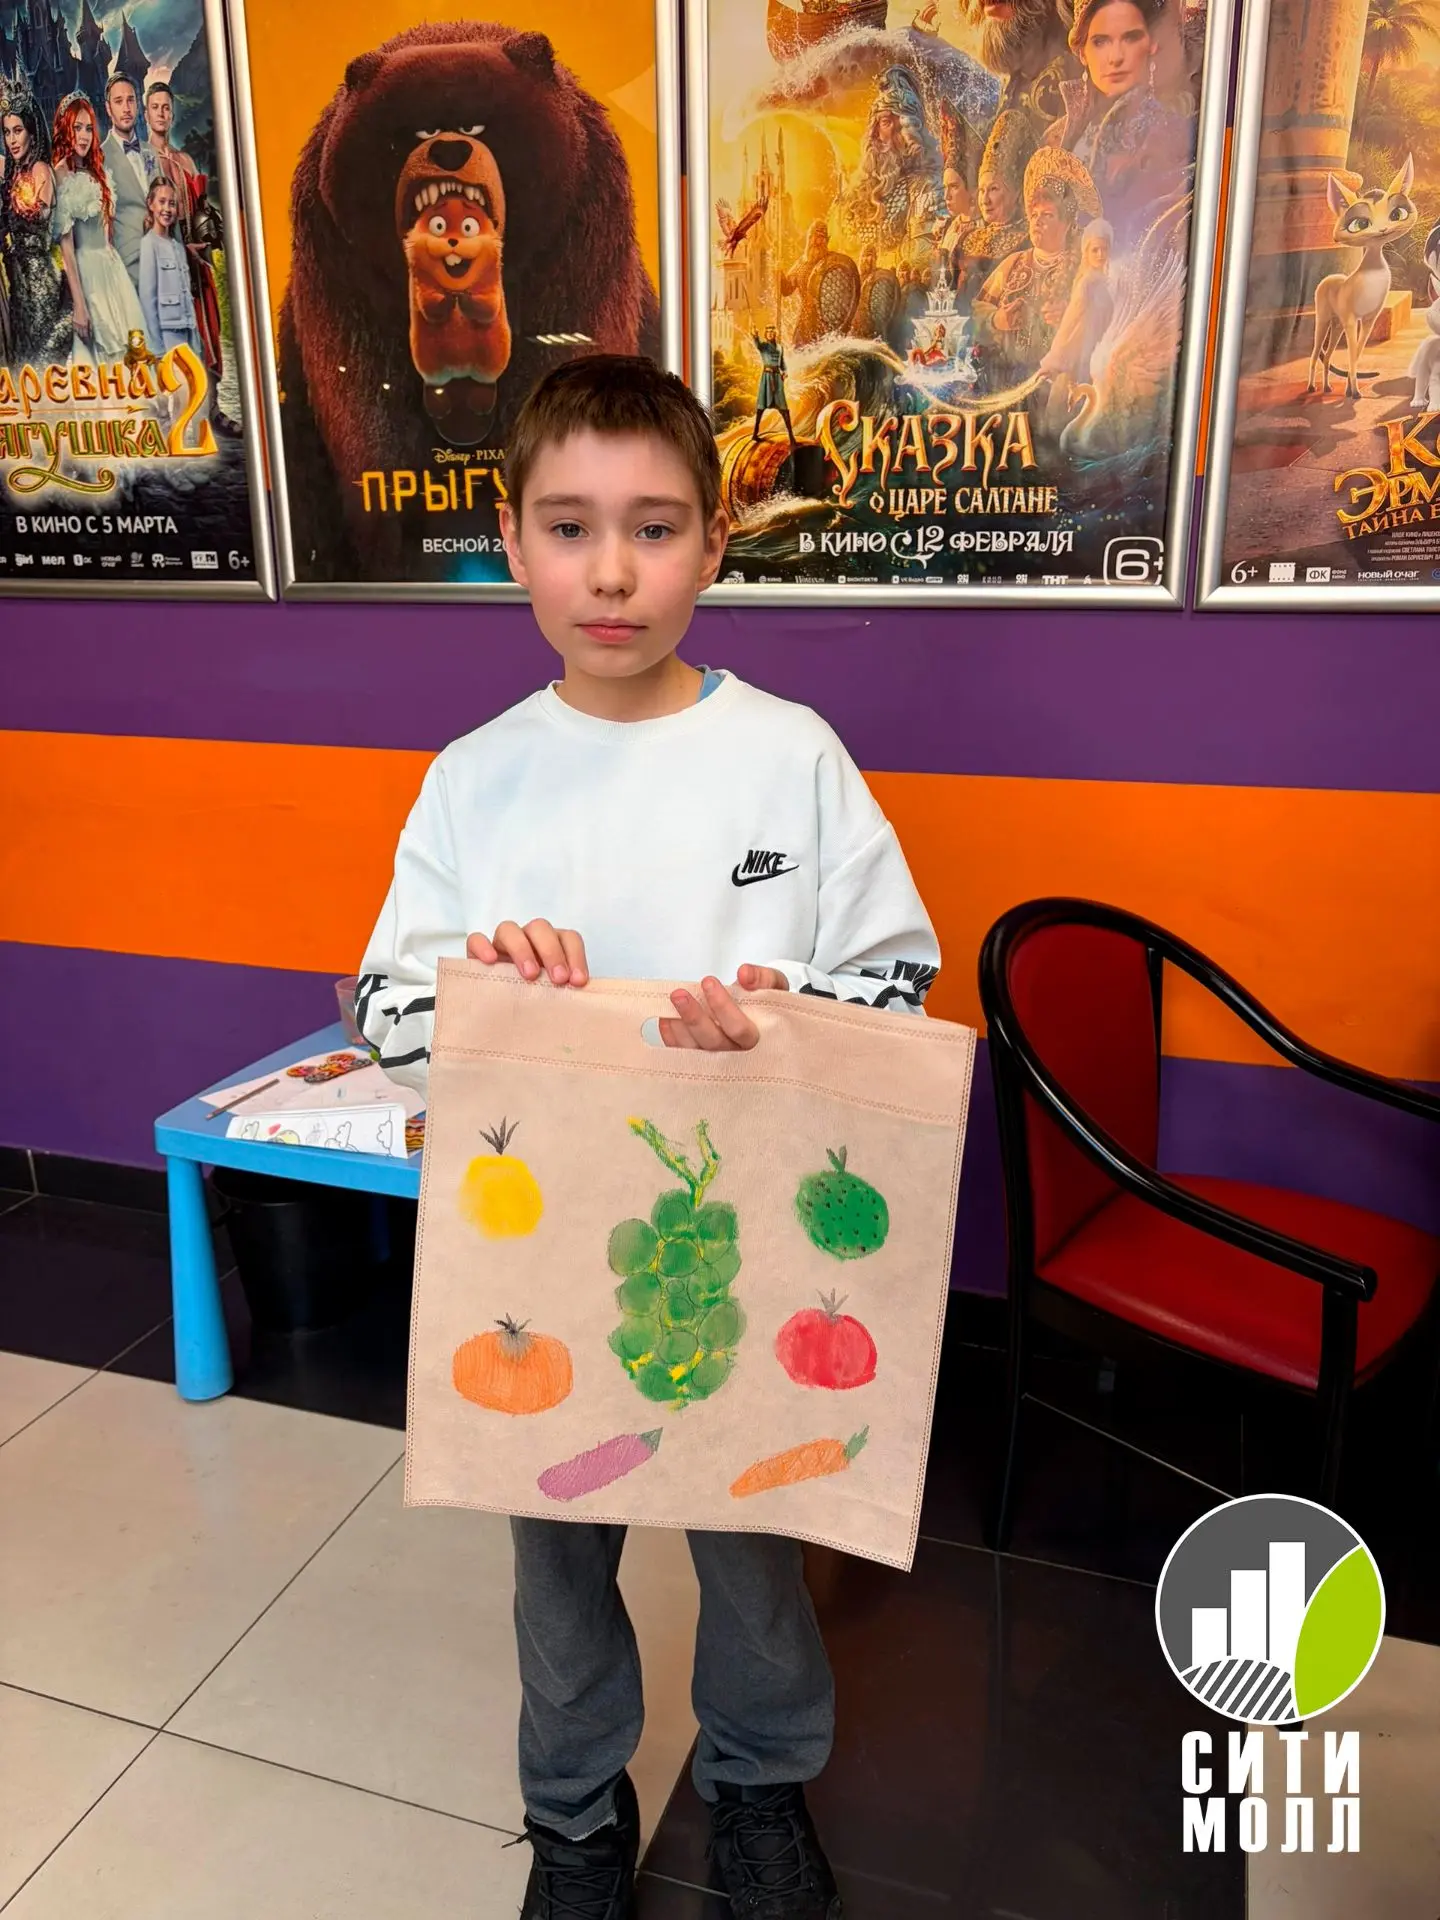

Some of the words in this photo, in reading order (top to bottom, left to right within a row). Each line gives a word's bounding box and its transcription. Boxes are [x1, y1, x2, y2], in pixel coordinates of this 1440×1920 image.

[158, 342, 219, 457] 2
[431, 448, 471, 466] Disney
[815, 399, 1039, 510] СКАЗКА
[888, 488, 948, 522] ЦАРЕ
[954, 486, 1059, 514] САЛТАНЕ
[16, 516, 28, 534] В
[31, 515, 82, 534] КИНО
[86, 515, 98, 534] С
[102, 516, 113, 534] 5
[117, 516, 179, 534] МАРТА
[1342, 506, 1424, 540] ТАЙНА
[422, 535, 490, 553] ВЕСНОЙ
[820, 532, 887, 557] КИНО
[916, 525, 945, 552] 12
[949, 530, 1074, 556] ФЕВРАЛЯ
[228, 550, 250, 570] 6+
[1115, 549, 1164, 580] 6+
[1231, 560, 1258, 584] 6+
[741, 849, 788, 874] NIKE
